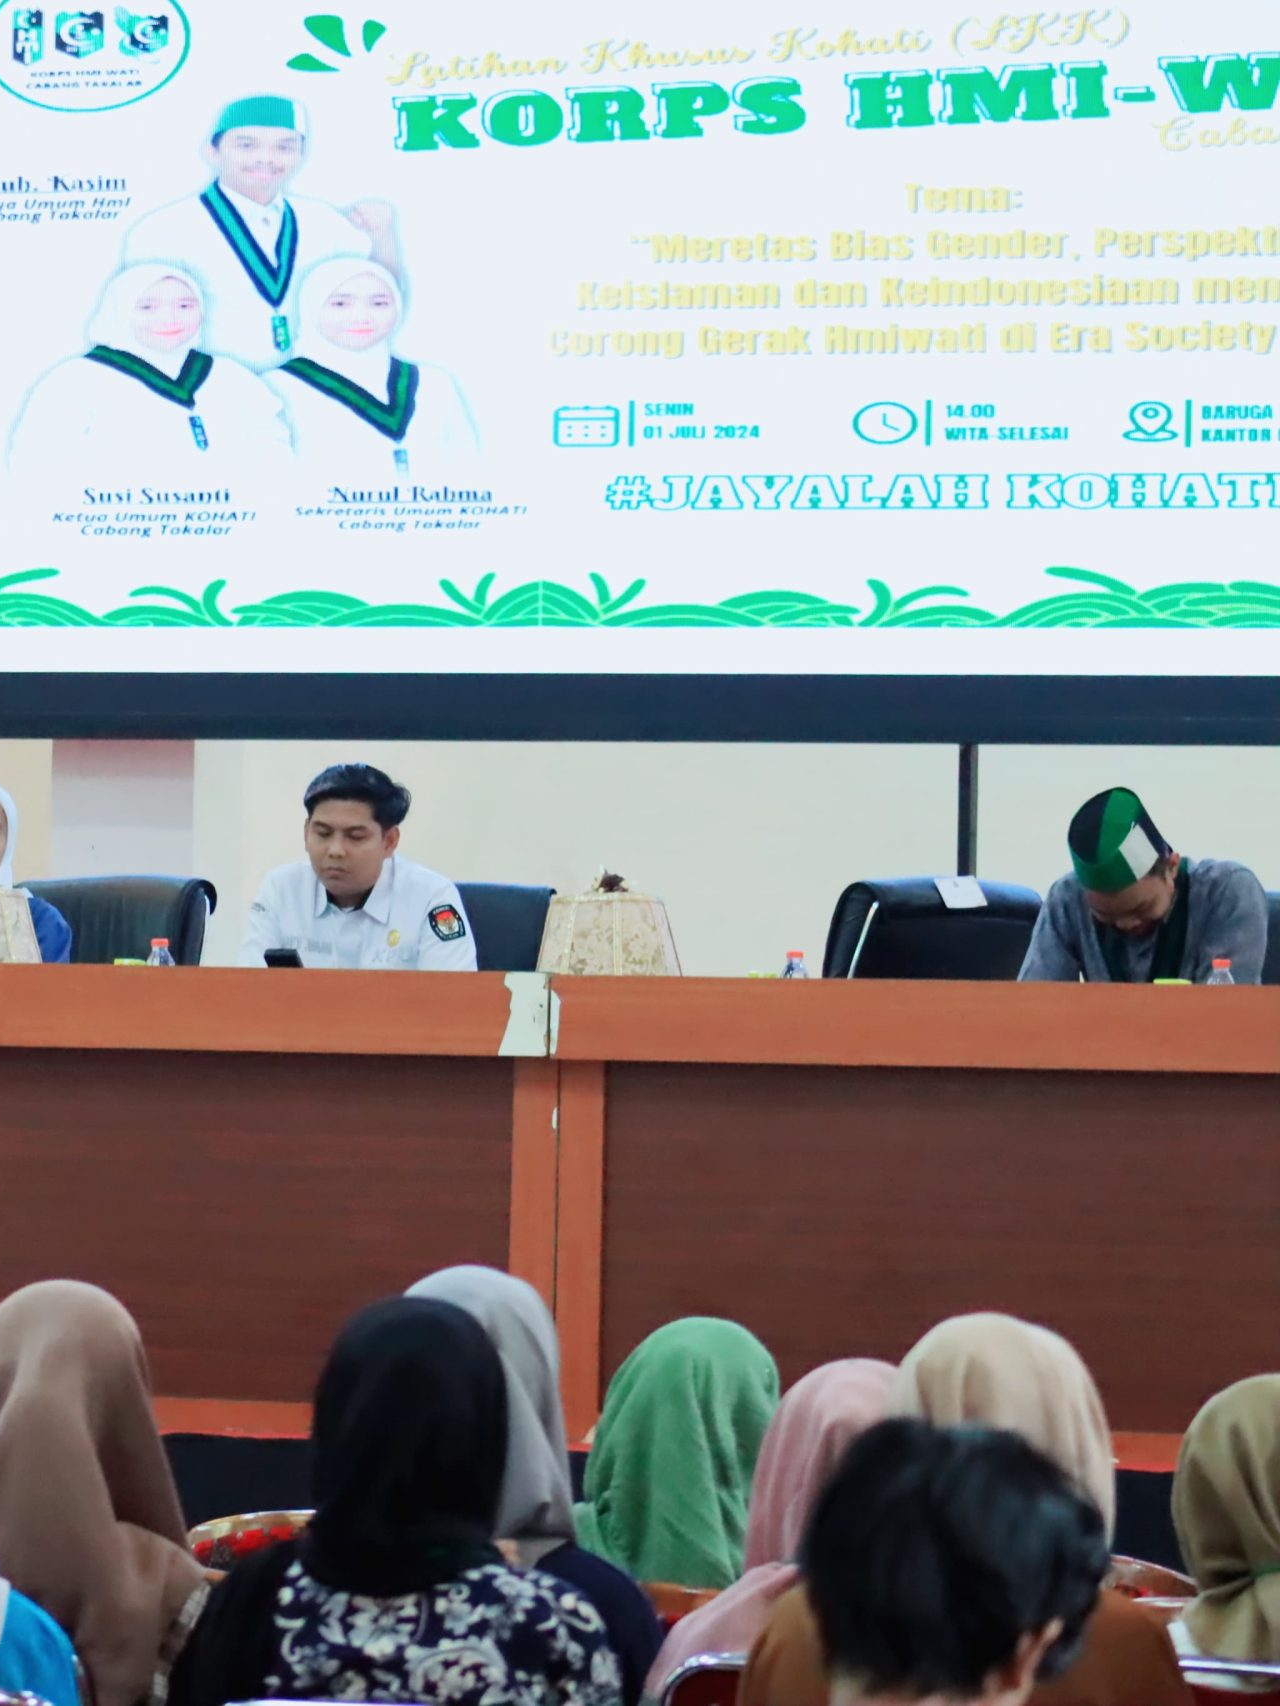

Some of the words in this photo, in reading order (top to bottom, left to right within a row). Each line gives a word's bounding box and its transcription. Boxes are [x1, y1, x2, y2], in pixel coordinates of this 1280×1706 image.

[386, 49, 568, 89] Latihan
[581, 39, 757, 74] Khusus
[768, 27, 933, 63] Kohati
[392, 75, 807, 152] KORPS
[47, 174, 128, 192] Kasim
[24, 199, 85, 210] Umum
[905, 182, 1024, 214] Tema:
[829, 228, 915, 262] Bias
[925, 227, 1081, 263] Gender,
[576, 279, 781, 311] Keislaman
[793, 277, 868, 309] dan
[880, 273, 1180, 308] Keindonesiaan
[547, 328, 685, 360] Corong
[697, 324, 814, 355] Gerak
[823, 321, 988, 355] Hmiwati
[999, 320, 1037, 353] di
[1050, 320, 1113, 353] Era
[1123, 319, 1278, 355] Society
[644, 403, 695, 417] SENIN
[1201, 404, 1273, 420] BARUGA
[643, 425, 663, 439] 01
[668, 425, 706, 439] JULI
[713, 425, 761, 439] 2024
[1201, 428, 1272, 442] KANTOR
[82, 487, 132, 505] Susi
[139, 487, 231, 505] Susanti
[327, 486, 399, 502] Nurul
[604, 474, 990, 511] #JAYALAH
[52, 512, 108, 522] Ketua
[114, 511, 178, 522] Umum
[184, 510, 257, 522] KOHATI
[295, 506, 387, 516] Sekretaris
[393, 506, 453, 515] Umum
[459, 505, 528, 515] KOHATI
[80, 524, 152, 537] Cabang
[338, 519, 406, 532] Cabang
